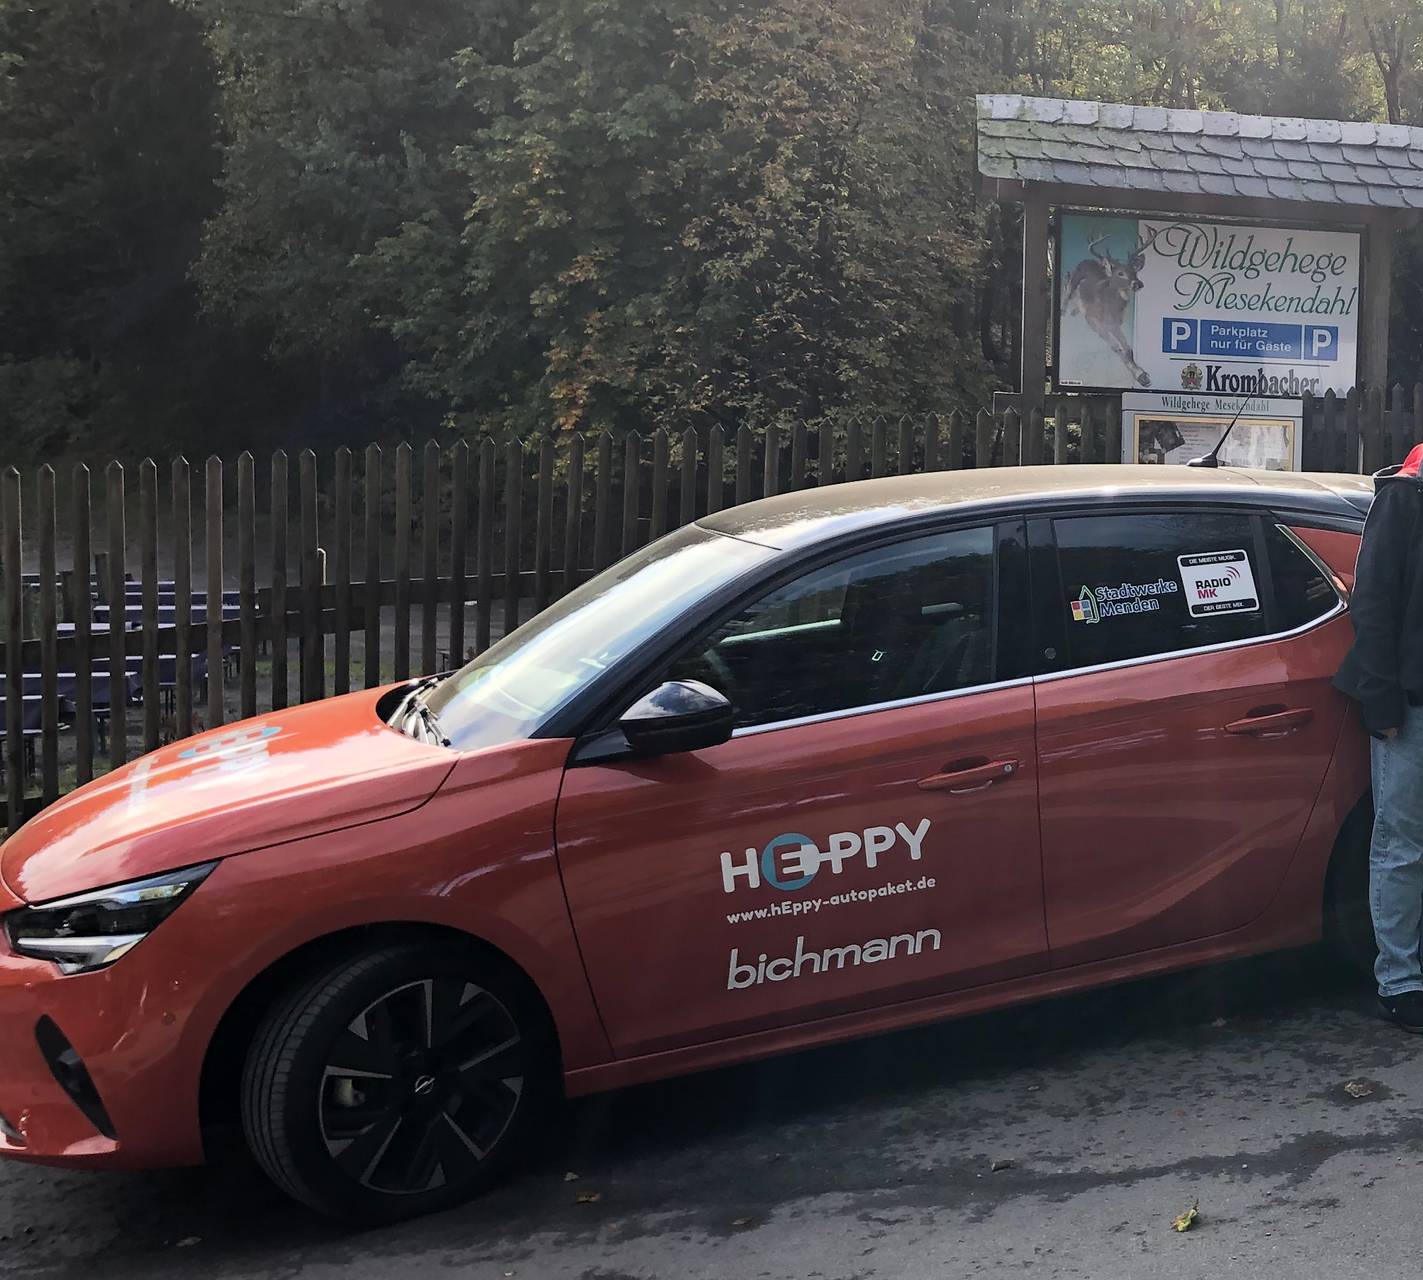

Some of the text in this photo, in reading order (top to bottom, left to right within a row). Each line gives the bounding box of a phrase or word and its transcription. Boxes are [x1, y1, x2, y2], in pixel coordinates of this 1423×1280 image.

[1153, 223, 1347, 283] Wildgehege
[1173, 272, 1358, 315] Mesekendahl
[1171, 321, 1191, 350] P
[1210, 340, 1231, 349] nur
[1235, 339, 1252, 350] für
[1211, 325, 1268, 338] Parkplatz
[1312, 329, 1332, 357] P
[1205, 365, 1320, 397] Krombacher
[1162, 396, 1210, 412] Wildgehege
[1095, 579, 1178, 602] Stadtwerke
[1195, 577, 1231, 590] RADIO
[1197, 588, 1218, 599] MK
[1101, 598, 1160, 618] Menden
[720, 818, 931, 893] HEPPY
[726, 876, 936, 924] www.hEppy-autopaket.de
[727, 928, 942, 990] bichmann
